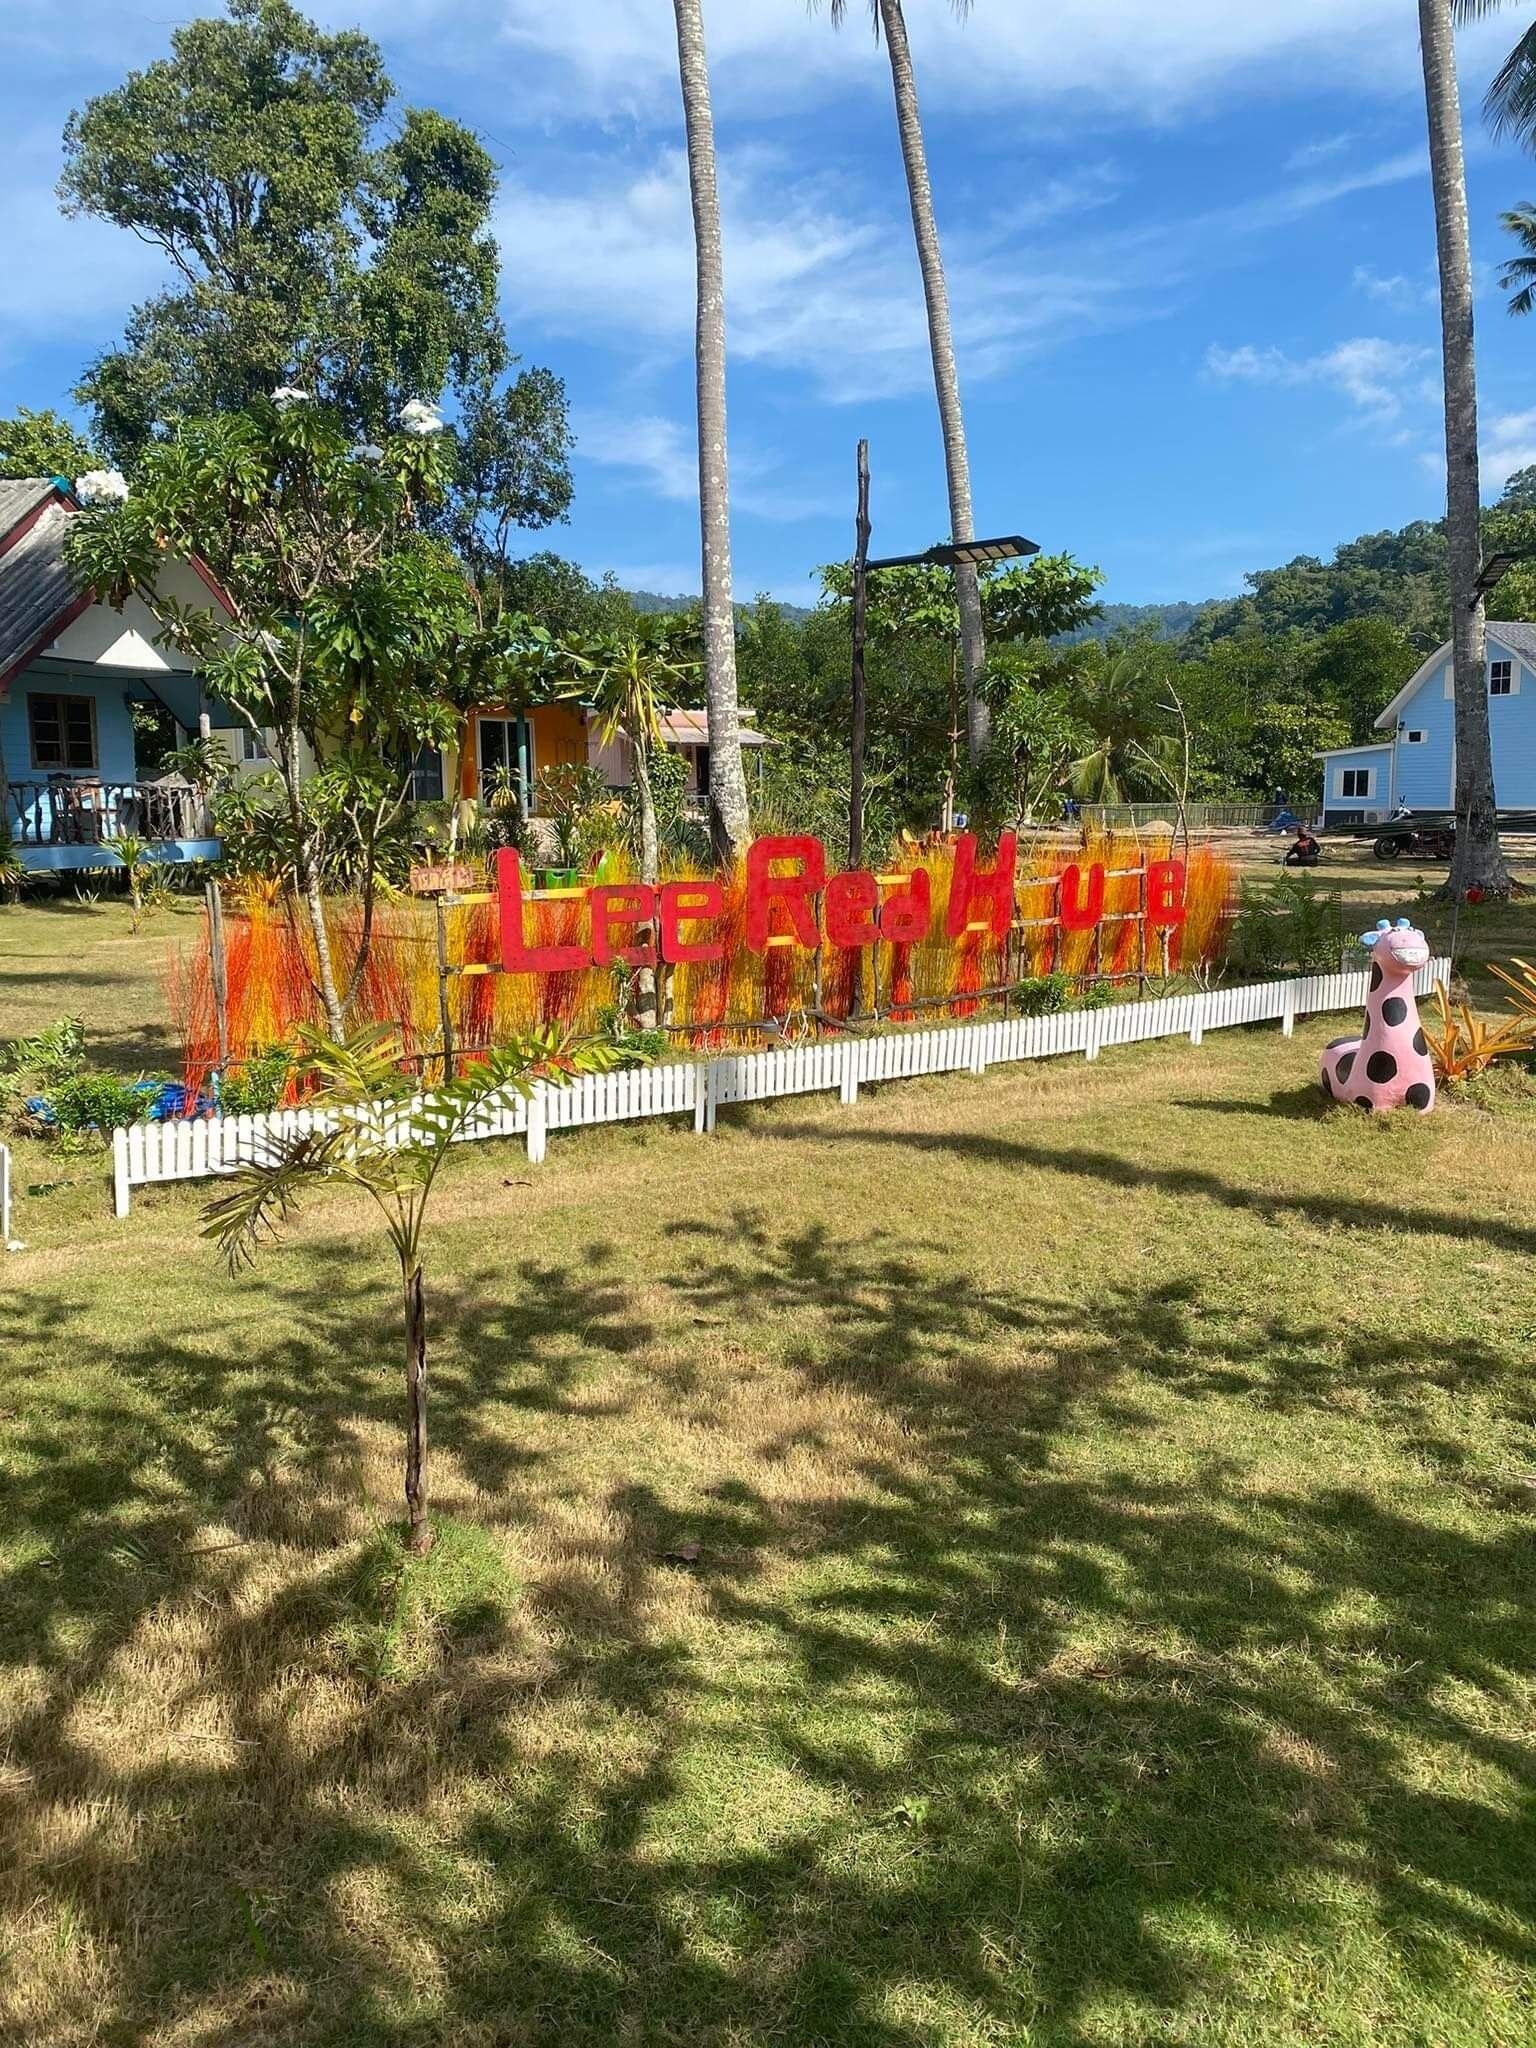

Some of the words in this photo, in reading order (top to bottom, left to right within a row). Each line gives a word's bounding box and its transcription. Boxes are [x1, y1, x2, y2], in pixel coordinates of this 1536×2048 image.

[497, 846, 724, 973] Lee
[746, 835, 931, 952] Red
[945, 831, 1186, 937] Hue
